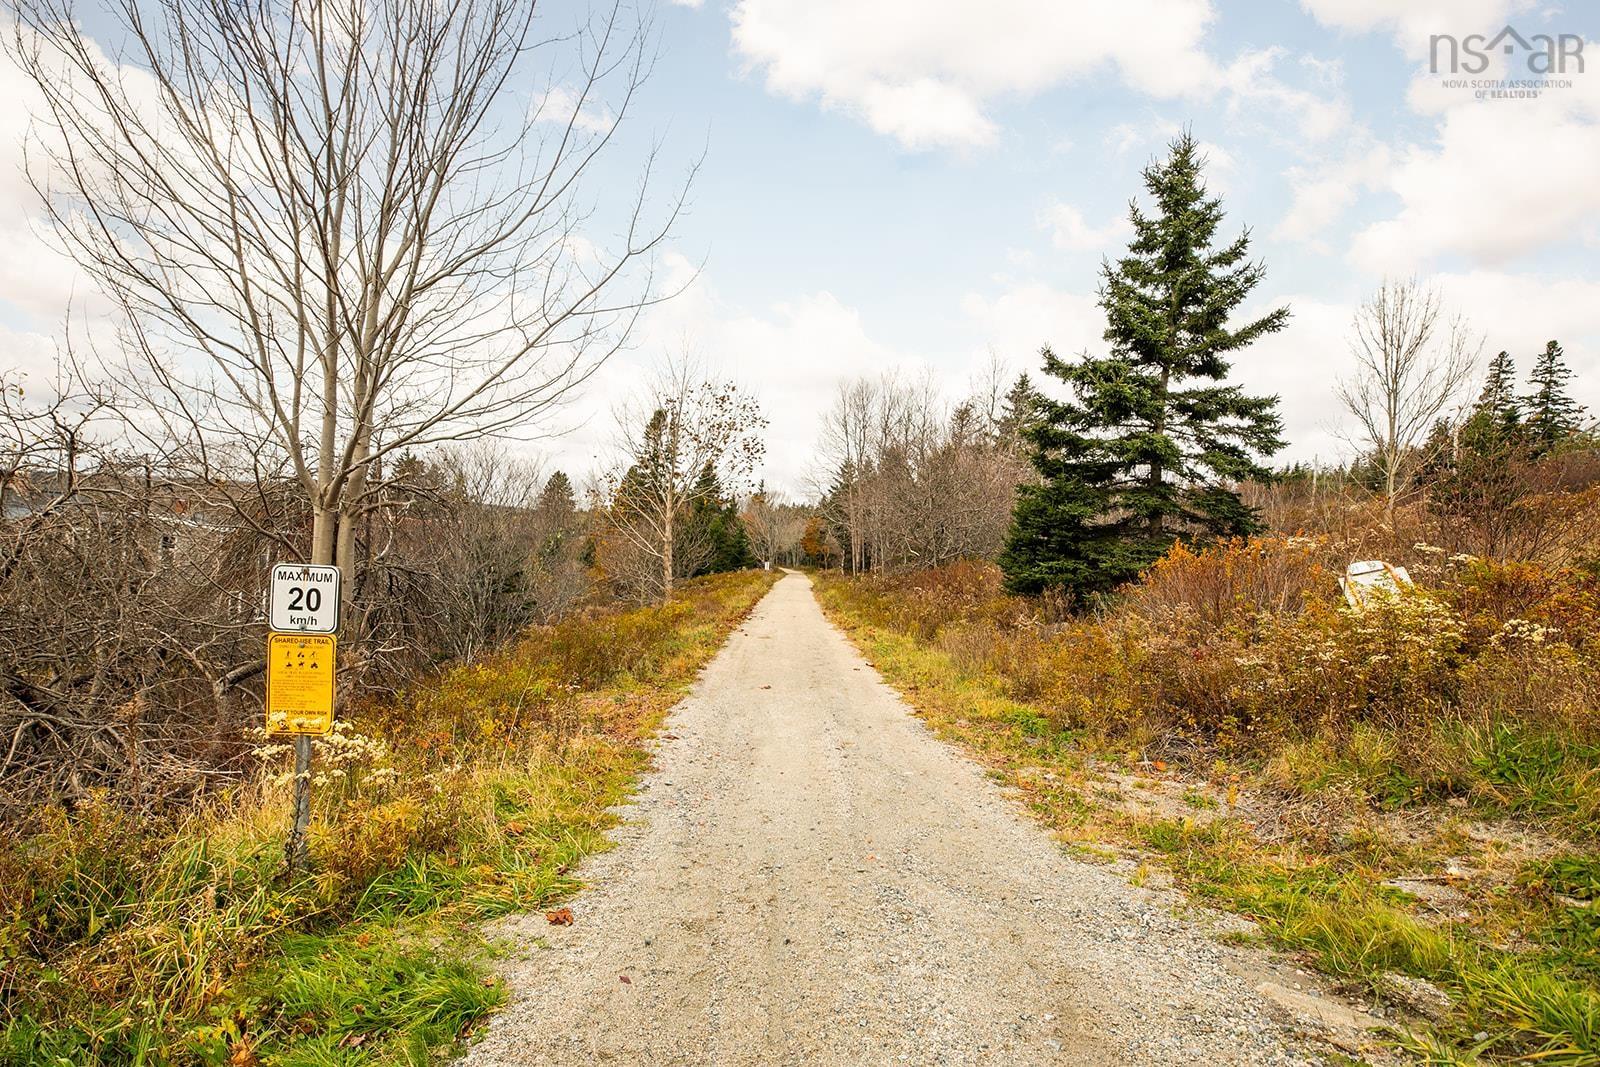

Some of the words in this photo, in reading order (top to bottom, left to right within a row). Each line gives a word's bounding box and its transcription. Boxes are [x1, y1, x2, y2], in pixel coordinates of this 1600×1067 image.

[278, 571, 333, 583] MAXIMUM
[288, 587, 321, 612] 20
[289, 615, 318, 626] km/h
